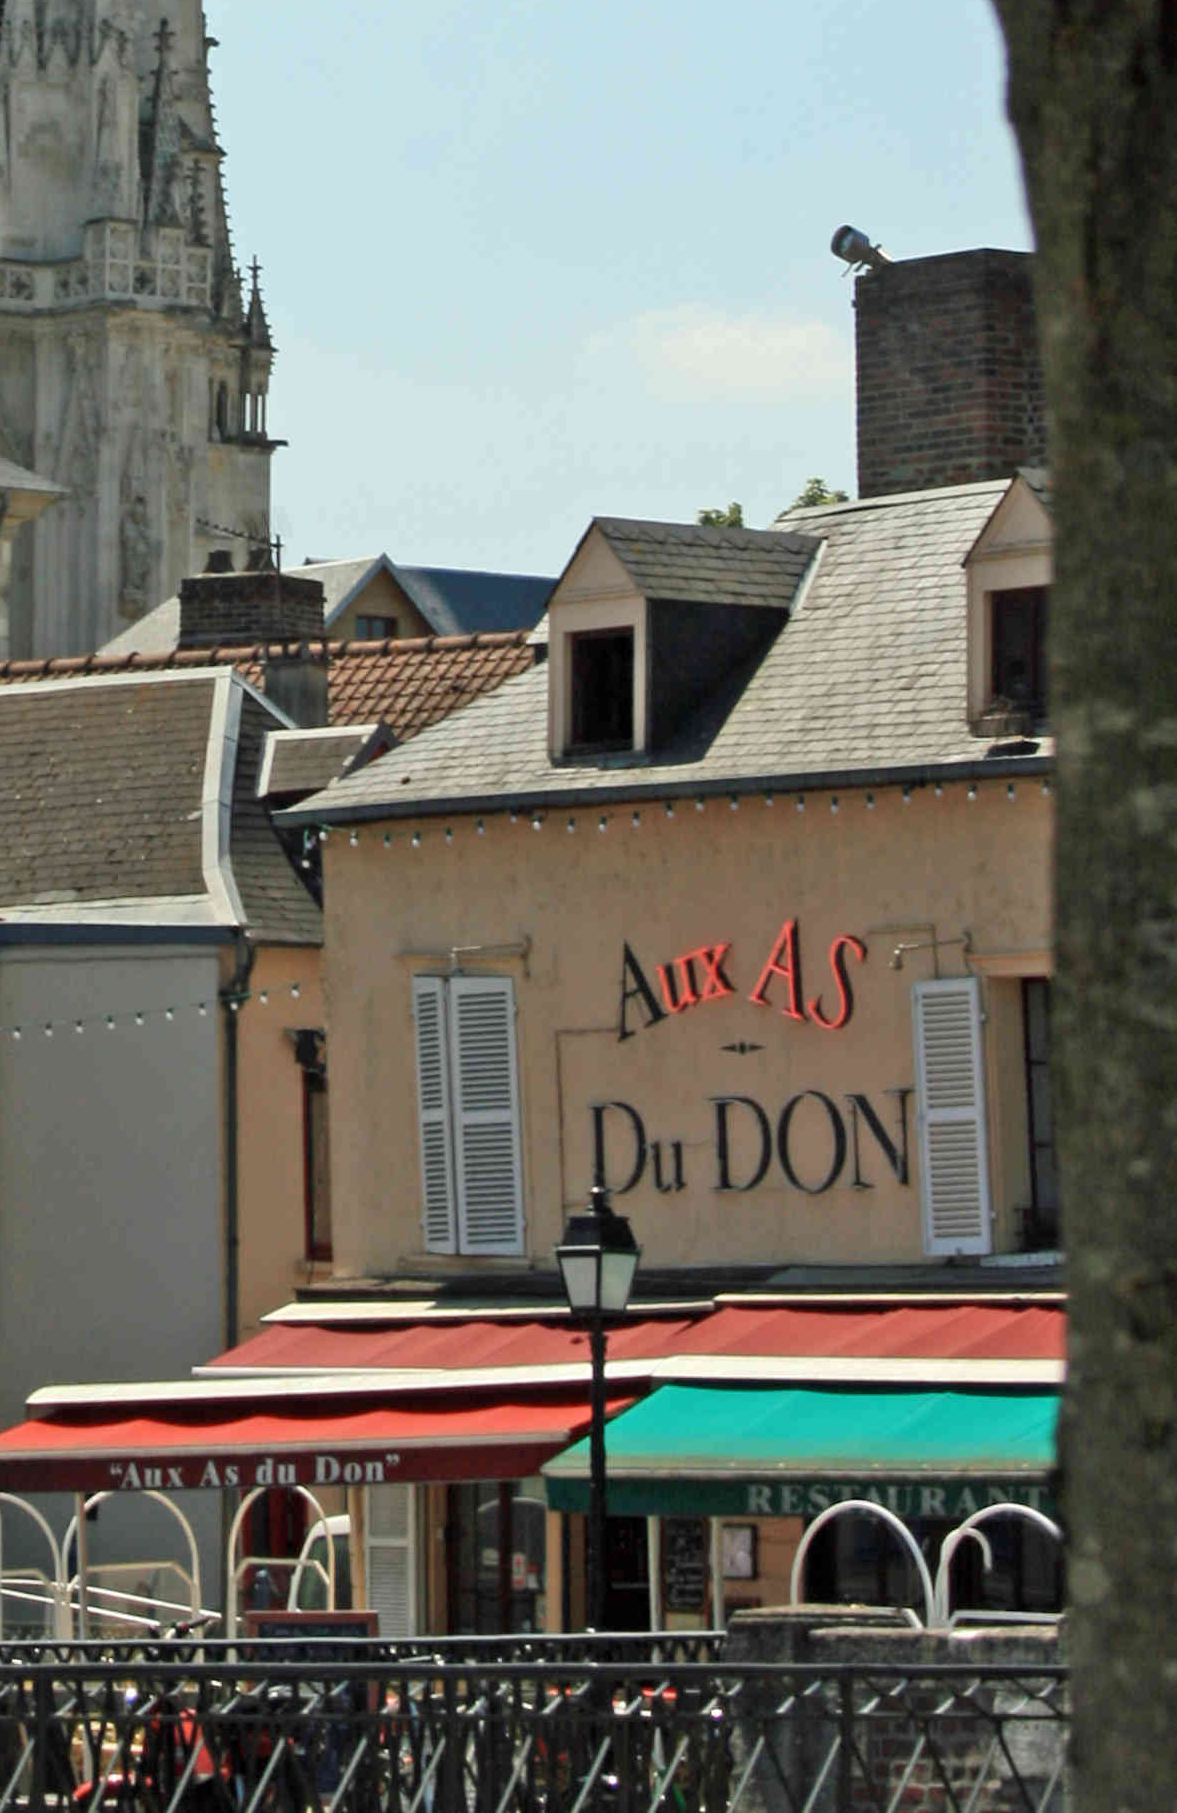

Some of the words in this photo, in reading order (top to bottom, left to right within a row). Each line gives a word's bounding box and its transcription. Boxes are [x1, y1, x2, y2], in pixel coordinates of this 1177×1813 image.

[618, 940, 736, 1042] Aux
[748, 917, 868, 1029] AS
[588, 1100, 687, 1194] Du
[707, 1088, 915, 1194] DON
[199, 1459, 239, 1486] As
[255, 1457, 296, 1484] du
